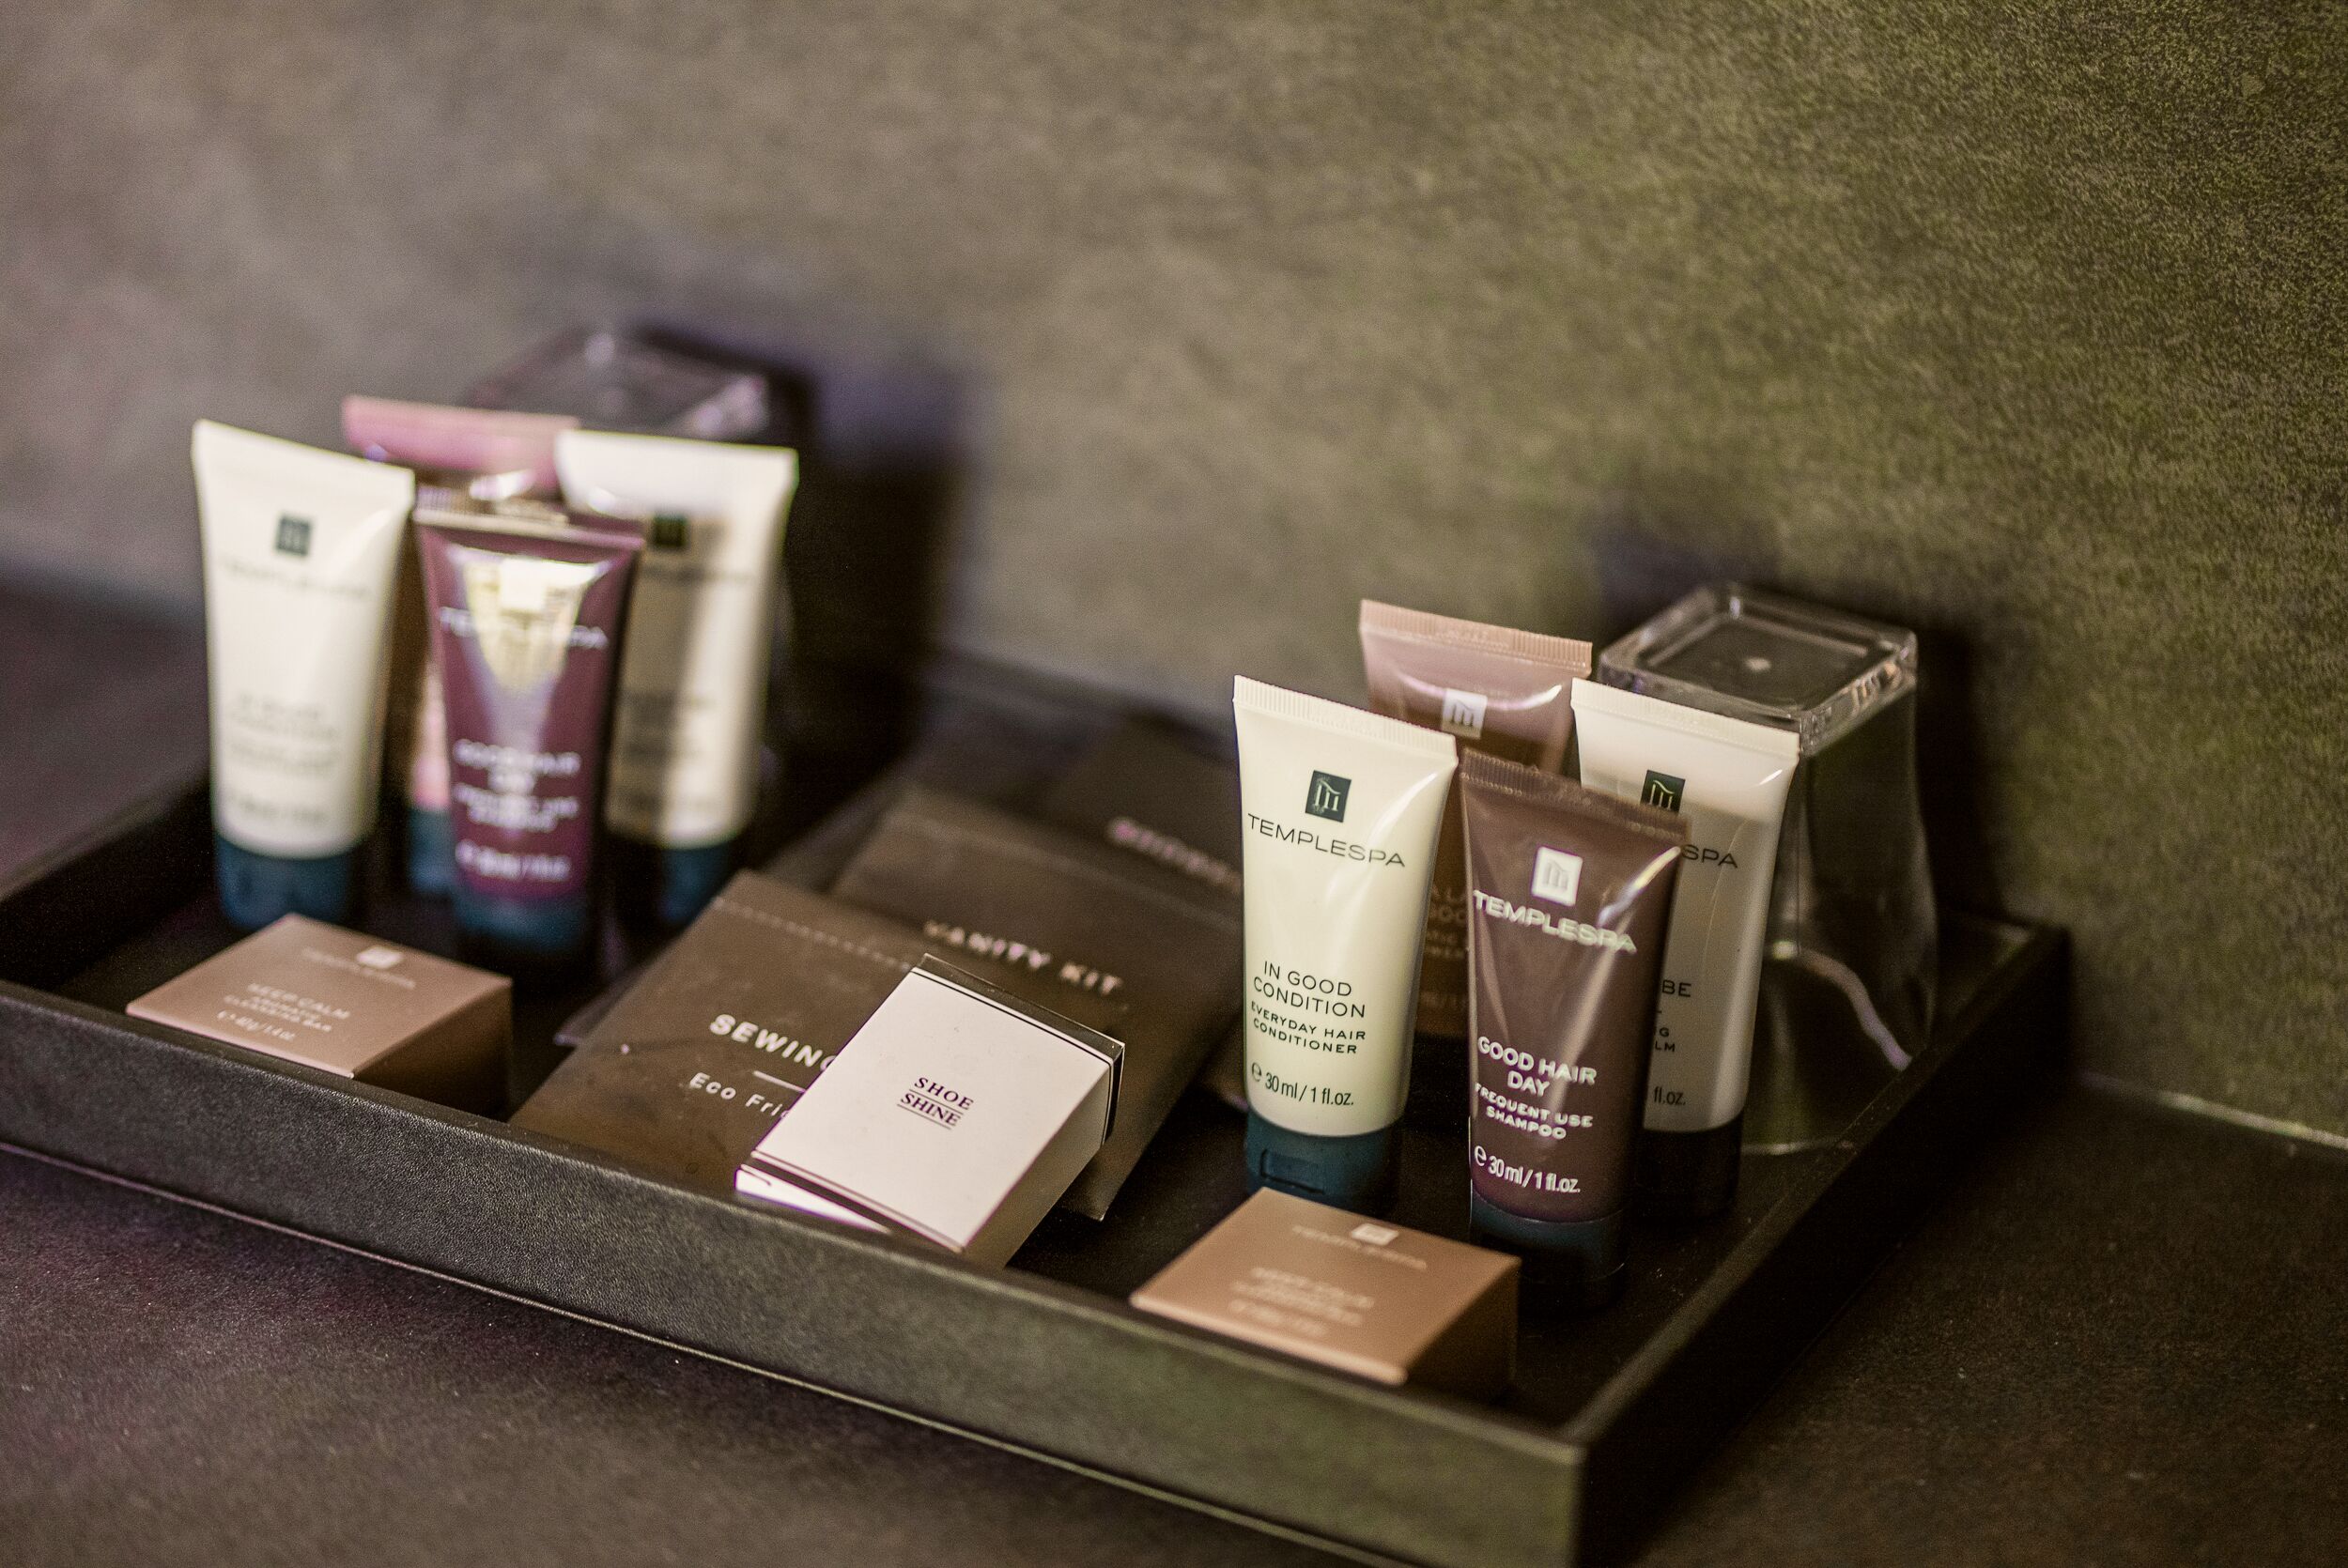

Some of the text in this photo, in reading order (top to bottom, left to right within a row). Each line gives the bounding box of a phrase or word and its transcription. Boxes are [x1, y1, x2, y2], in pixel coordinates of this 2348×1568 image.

[1247, 813, 1405, 868] TEMPLESPA
[1472, 889, 1637, 955] TEMPLESPA
[924, 921, 1122, 996] VANITY KIT
[1254, 976, 1366, 1018] CONDITION
[1264, 961, 1352, 996] IN GOOD
[1251, 1001, 1366, 1040] EVERYDAY HAIR
[1253, 1018, 1357, 1053] CONDITIONER
[1477, 1036, 1598, 1084] GOOD HAIR
[689, 1072, 736, 1100] Eco
[914, 1077, 974, 1110] SHOE
[1507, 1070, 1550, 1097] DAY
[900, 1093, 961, 1127] SHINE
[1475, 1082, 1594, 1128] FREQUENT USE
[1486, 1105, 1567, 1140] SHAMPOO
